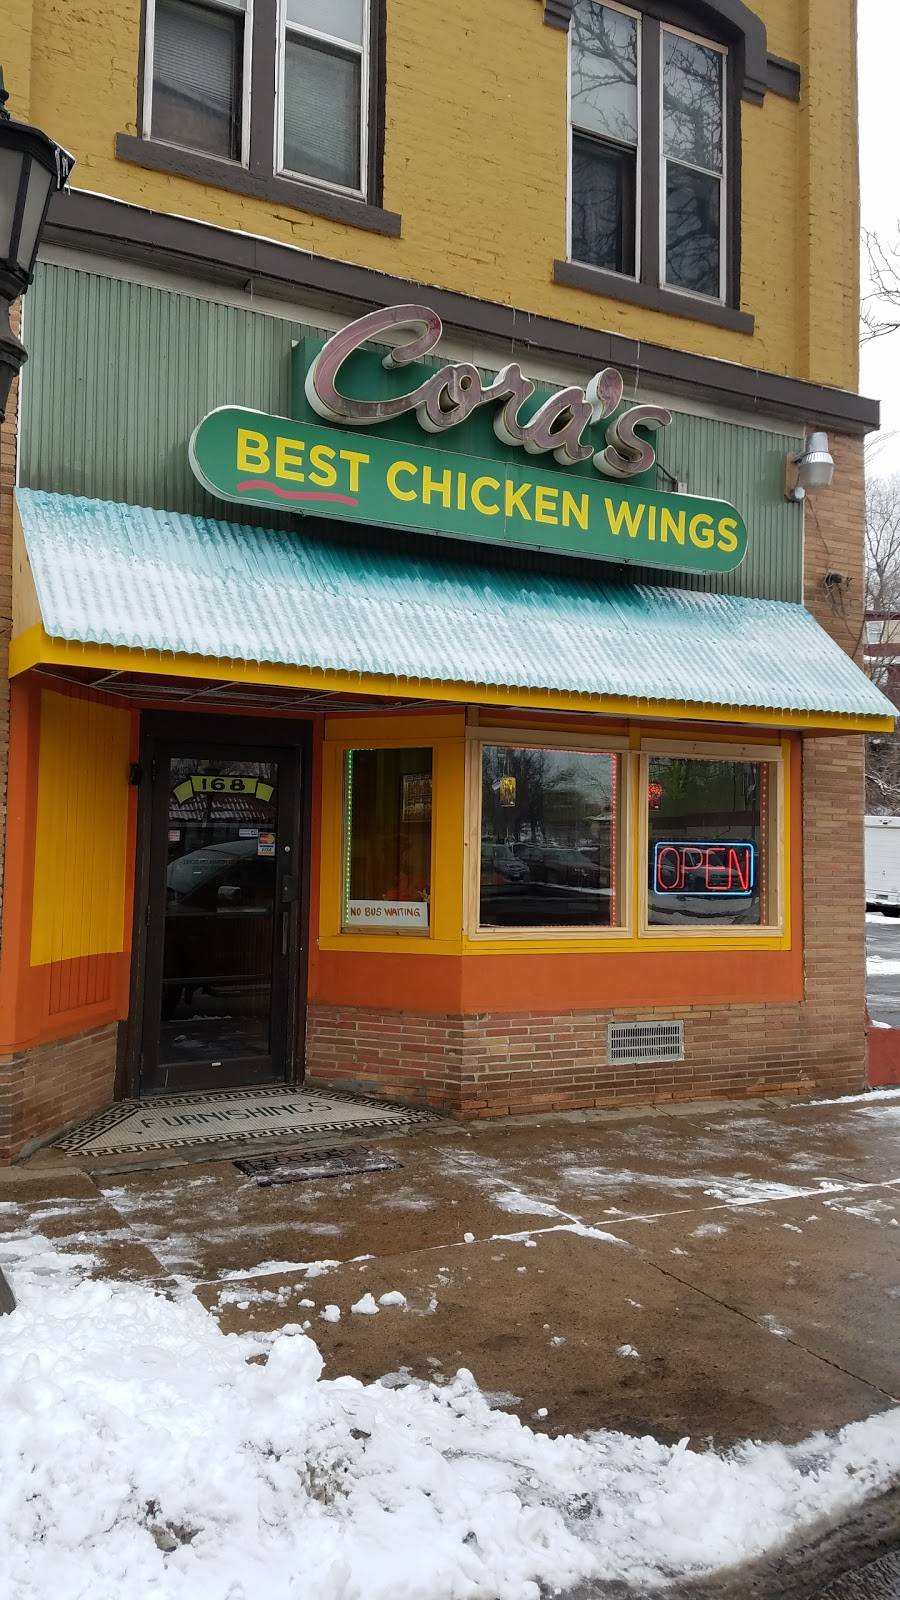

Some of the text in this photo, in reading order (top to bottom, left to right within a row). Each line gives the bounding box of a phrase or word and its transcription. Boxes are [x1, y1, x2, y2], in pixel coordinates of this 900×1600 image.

[305, 304, 672, 478] Cora's
[236, 428, 738, 552] BEST CHICKEN WINGS
[202, 778, 246, 792] 168
[657, 847, 750, 891] OPEN
[350, 907, 421, 918] NO BUS WAITING
[140, 1101, 333, 1128] FURNISHINGS
